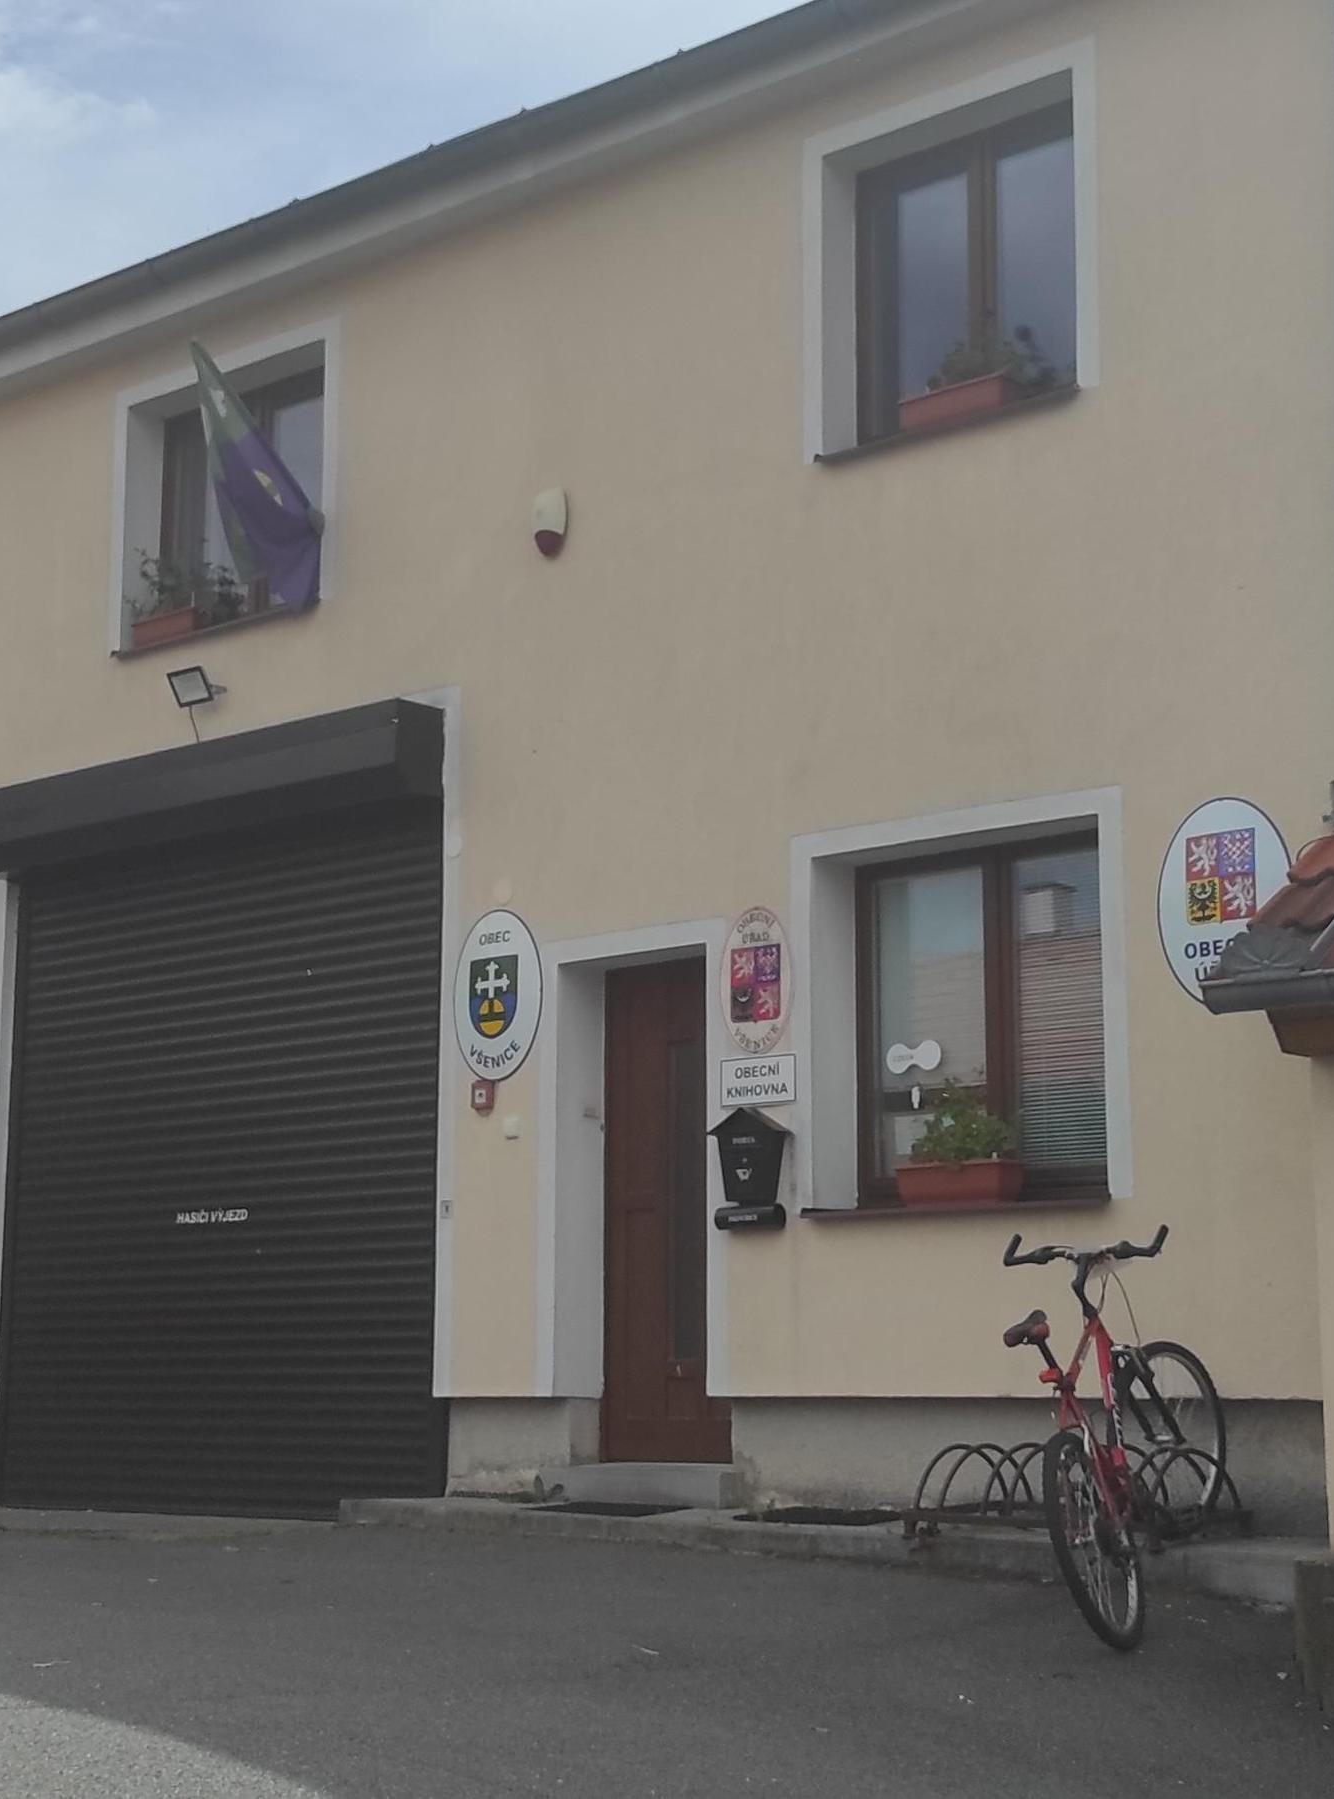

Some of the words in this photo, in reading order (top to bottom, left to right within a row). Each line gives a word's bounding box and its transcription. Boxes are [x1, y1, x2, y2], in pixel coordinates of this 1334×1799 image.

[479, 930, 511, 946] OBEC
[469, 1039, 521, 1069] VŠENICE
[734, 1061, 780, 1080] OBECNÍ
[726, 1082, 788, 1098] KNIHOVNA
